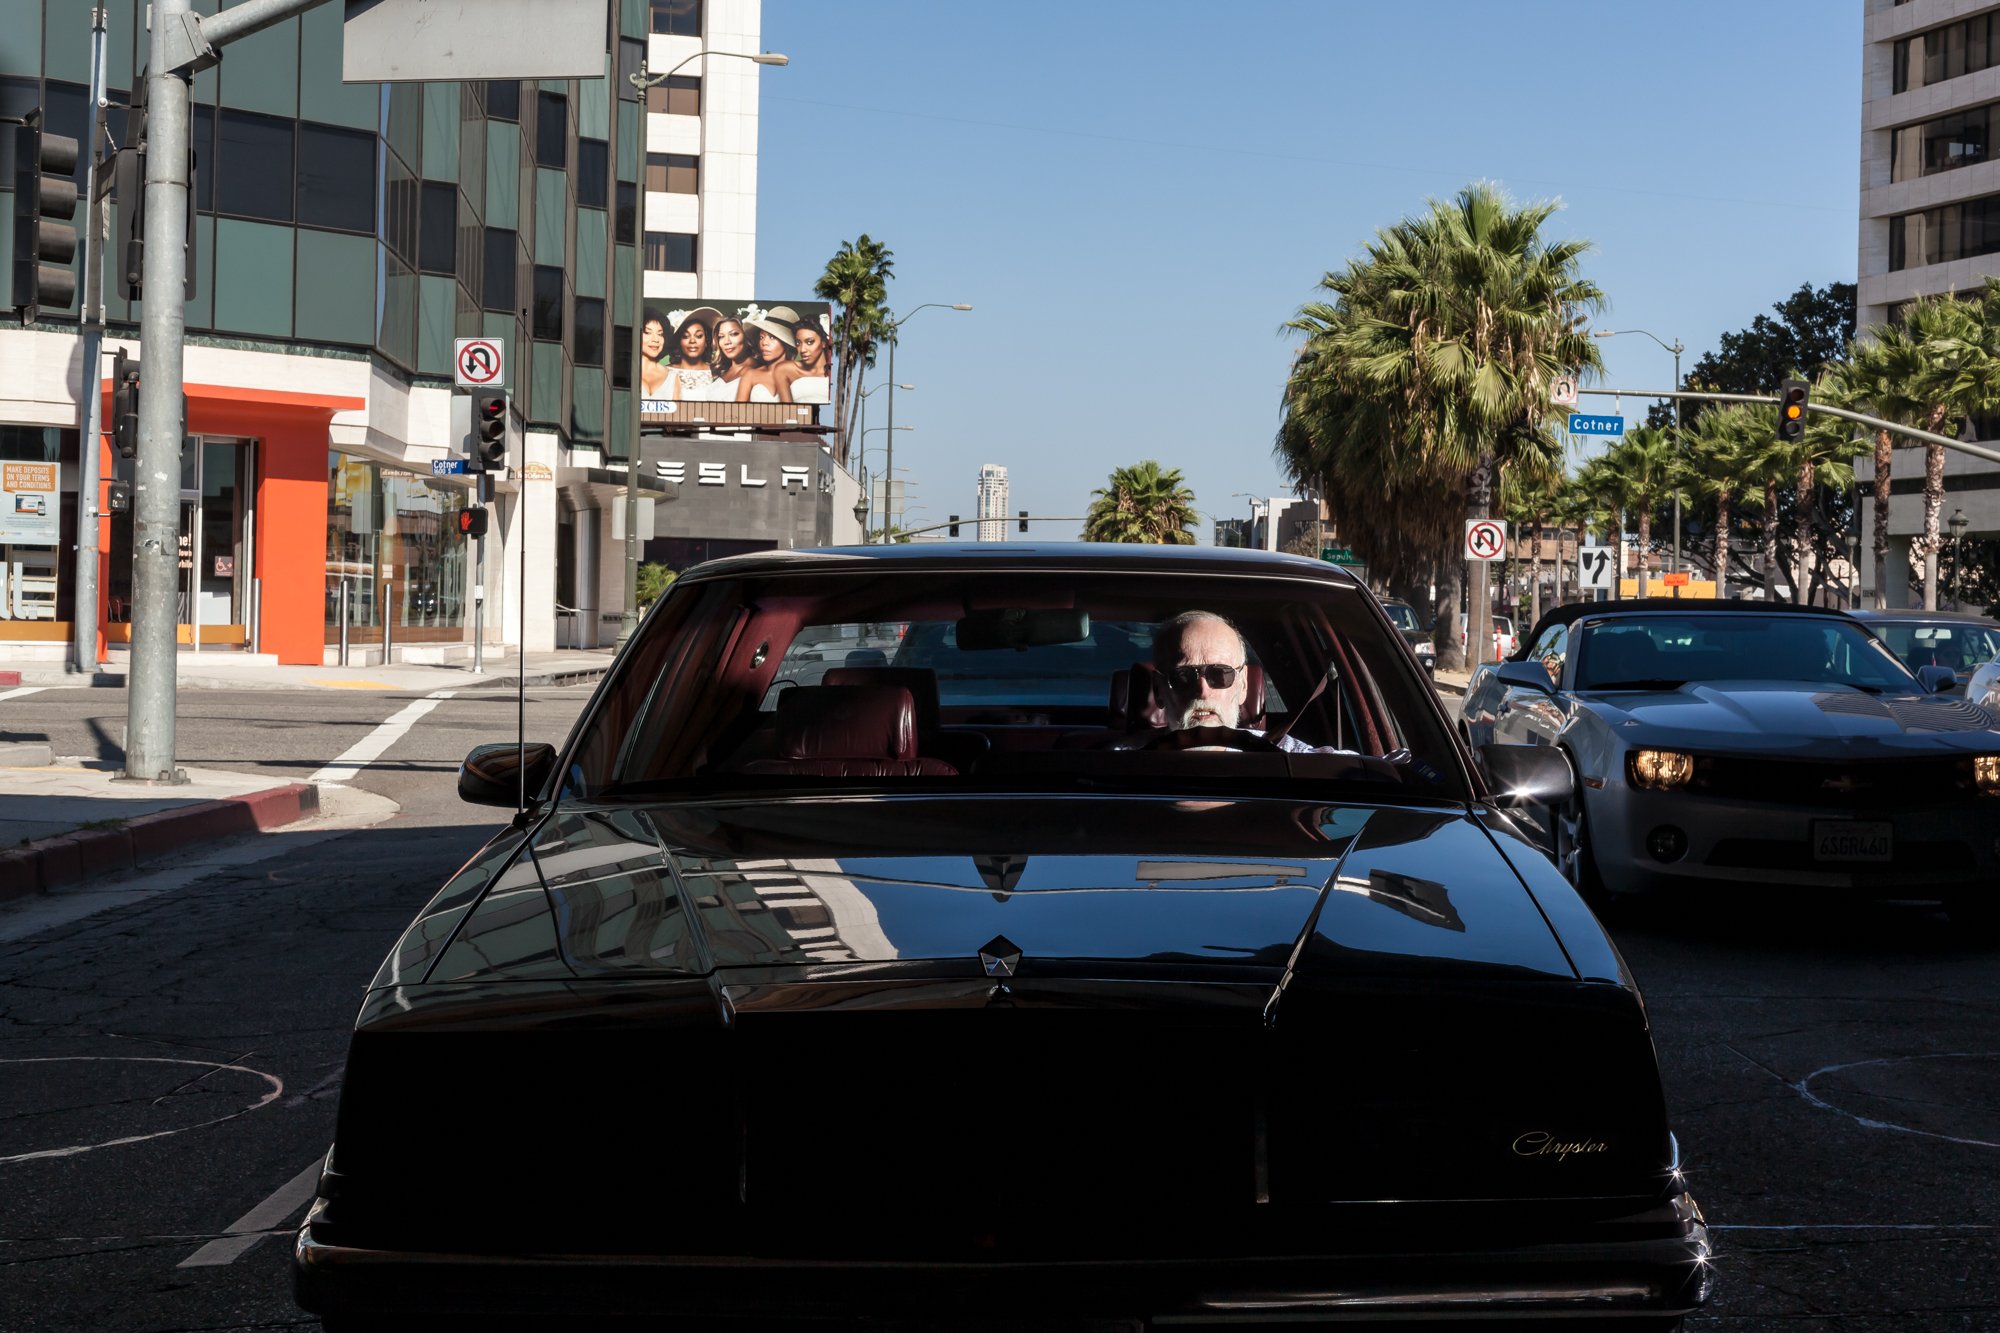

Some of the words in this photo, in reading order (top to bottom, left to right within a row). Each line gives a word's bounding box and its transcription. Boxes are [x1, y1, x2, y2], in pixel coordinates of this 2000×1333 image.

[646, 401, 670, 411] CBS
[1574, 419, 1619, 431] Cotner
[433, 460, 458, 469] Cotner
[6, 465, 23, 473] MAKE
[23, 466, 50, 474] DEPOSITS
[637, 460, 809, 488] ESLA
[6, 473, 15, 481] ON
[15, 473, 31, 481] YOUR
[32, 474, 50, 482] TERMS
[6, 480, 18, 488] AND
[1512, 1131, 1608, 1162] Chrysler
